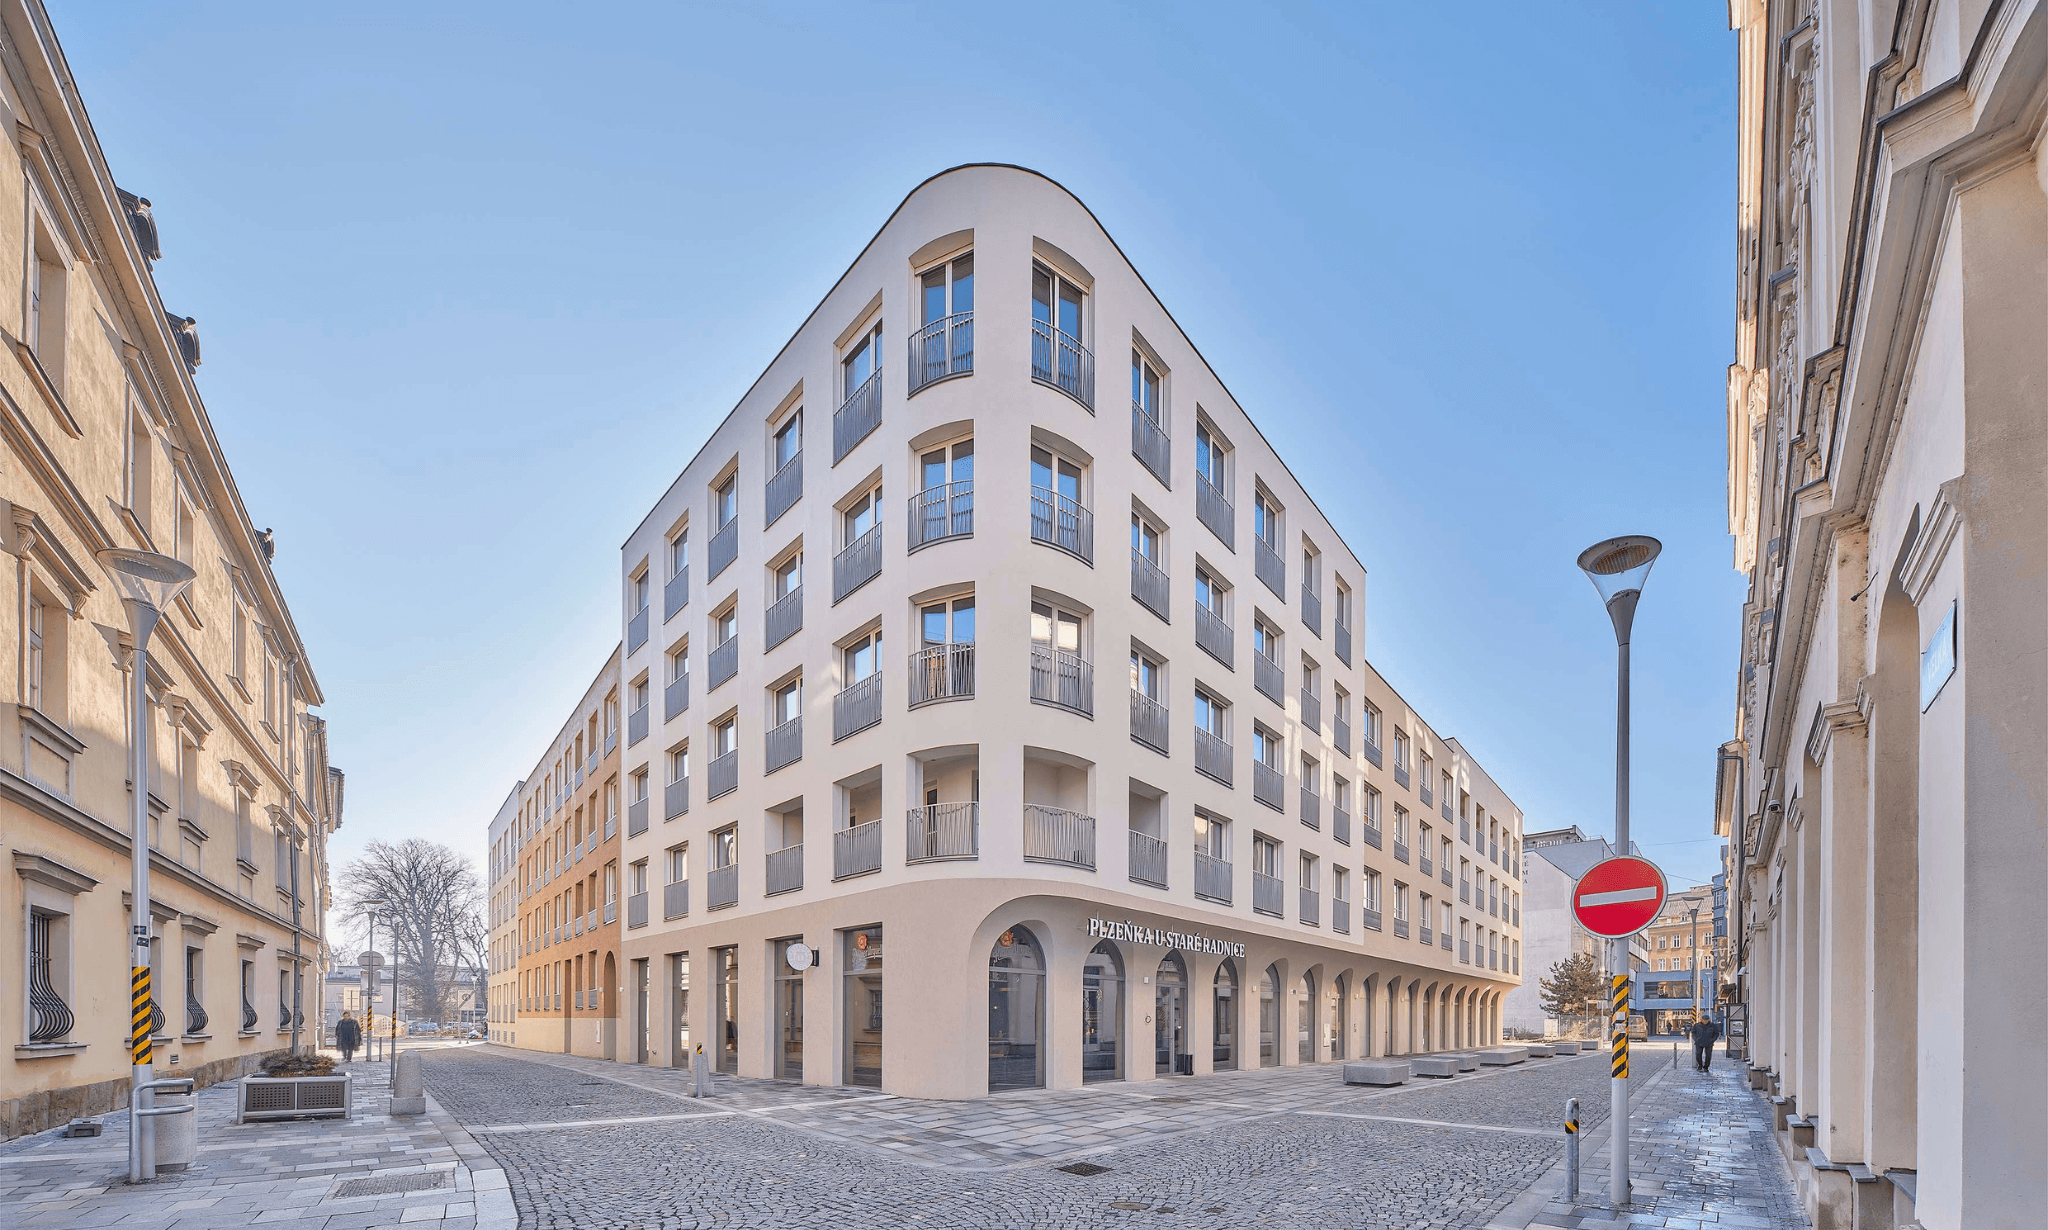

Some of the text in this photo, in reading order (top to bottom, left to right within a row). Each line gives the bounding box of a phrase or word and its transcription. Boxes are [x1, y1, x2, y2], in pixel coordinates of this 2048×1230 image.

[1088, 918, 1245, 958] PLZEŇKA U STARÉ RADNICE
